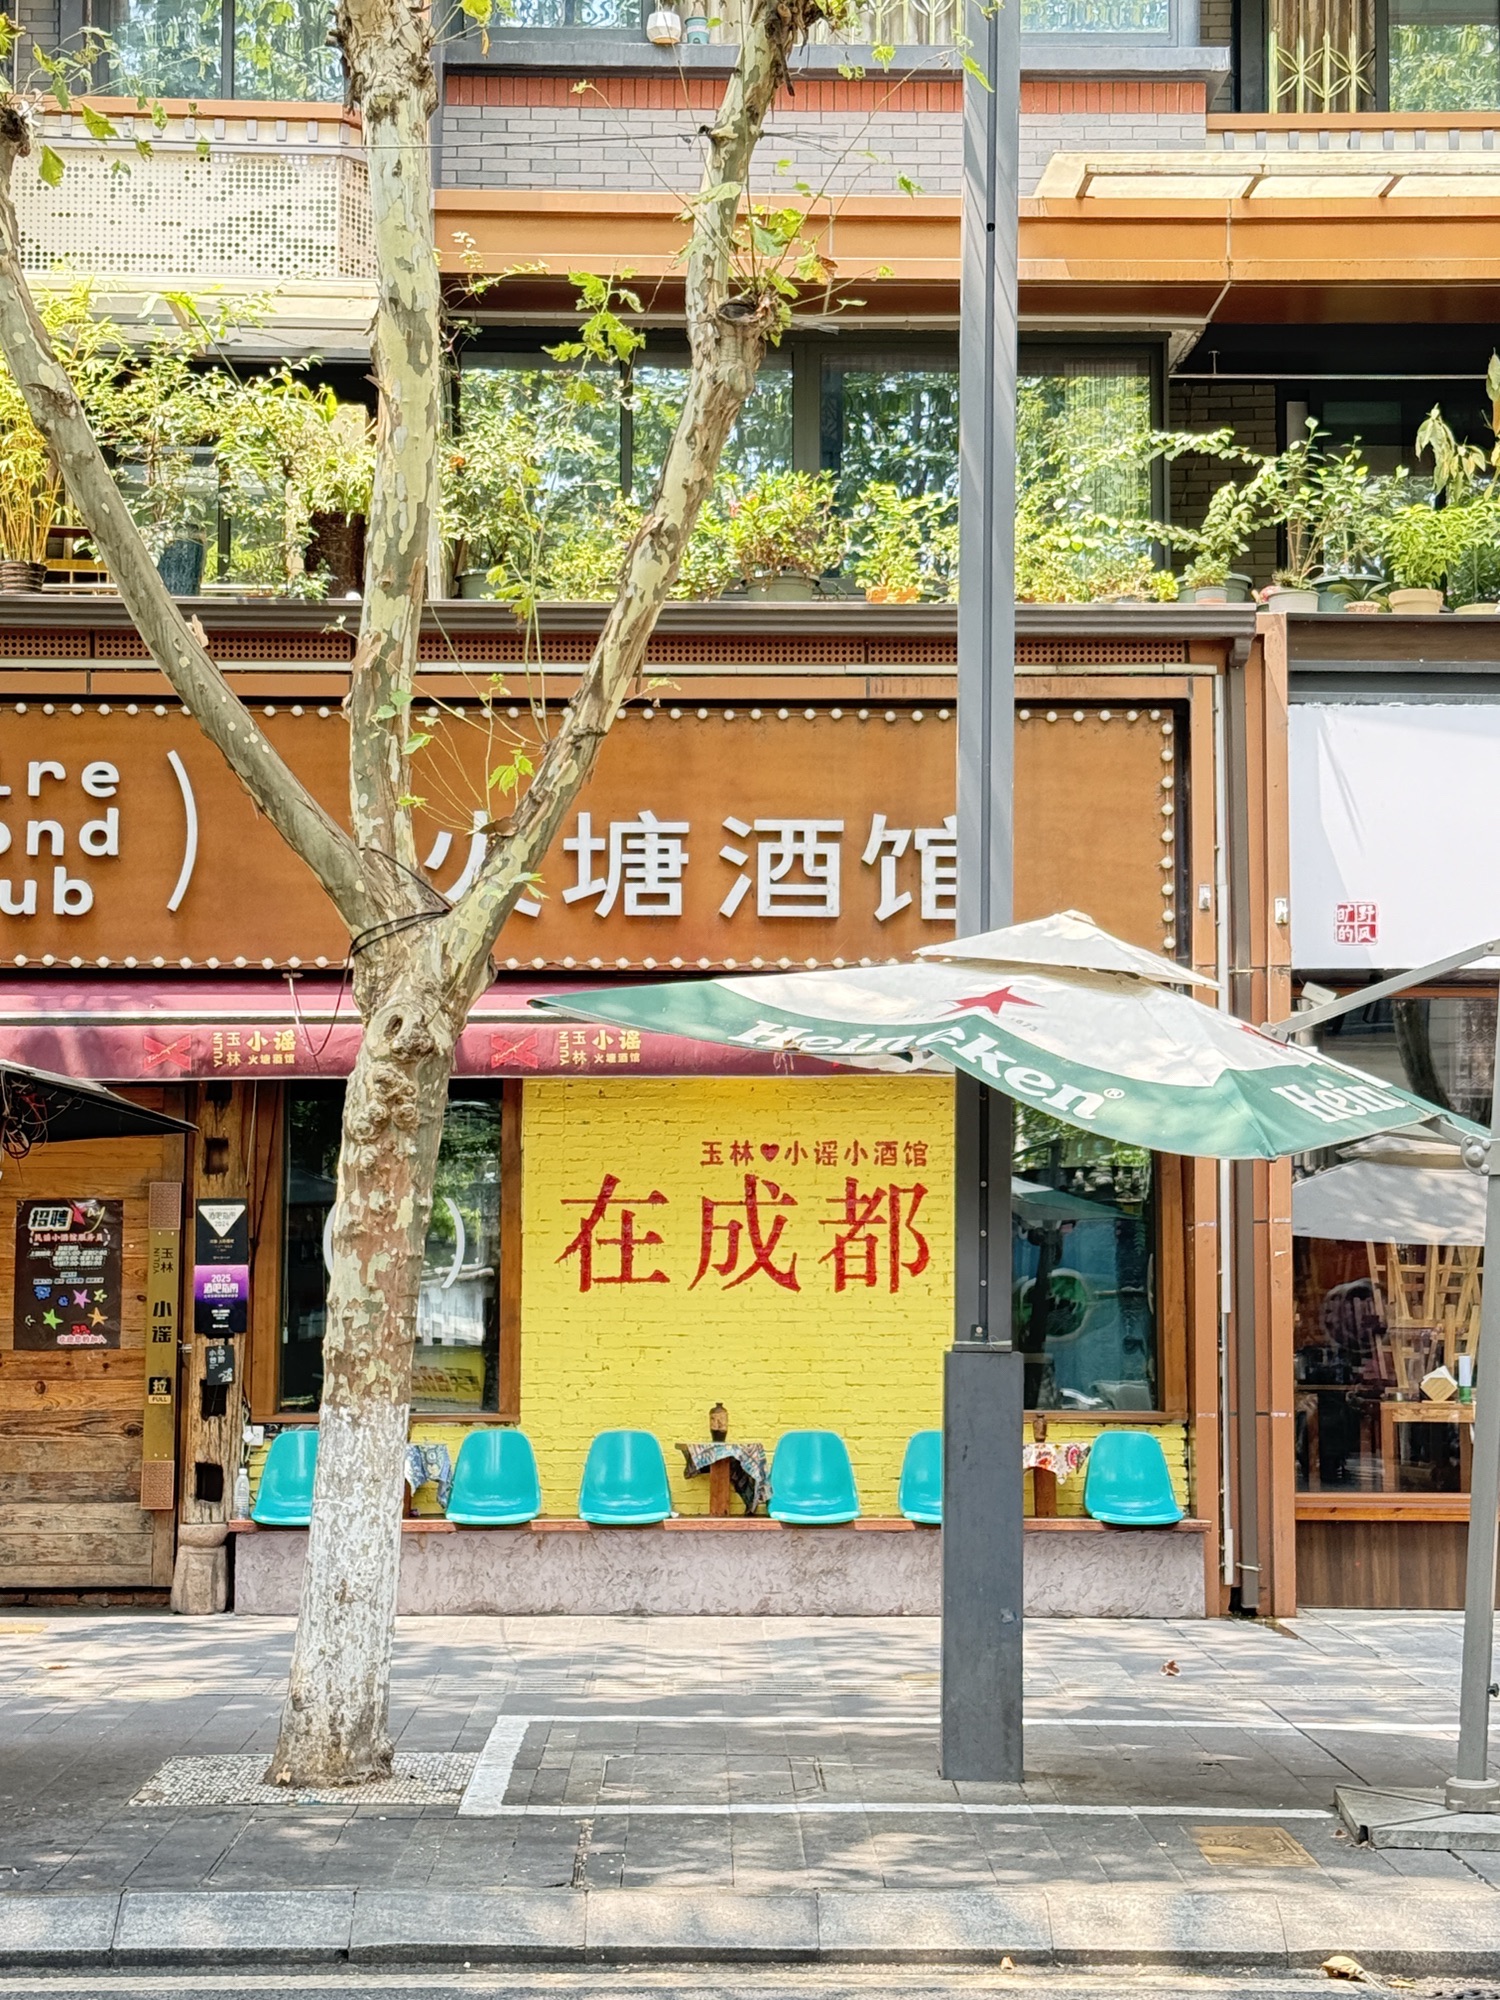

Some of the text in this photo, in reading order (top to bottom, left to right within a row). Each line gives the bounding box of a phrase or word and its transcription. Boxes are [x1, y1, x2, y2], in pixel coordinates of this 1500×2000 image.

[0, 761, 120, 798] re
[212, 1032, 223, 1067] YULIN
[226, 1032, 241, 1066] 玉林
[246, 1029, 296, 1052] 小谣
[558, 1031, 570, 1066] YULIN
[572, 1030, 587, 1065] 玉林
[592, 1029, 641, 1051] 小谣
[30, 1207, 70, 1228] 招聘
[554, 1173, 930, 1294] 在成都
[152, 1247, 160, 1274] YULIN
[161, 1247, 174, 1273] 玉林
[211, 1273, 231, 1283] 2025
[152, 1300, 173, 1343] 小谣
[152, 1379, 168, 1395] 拉
